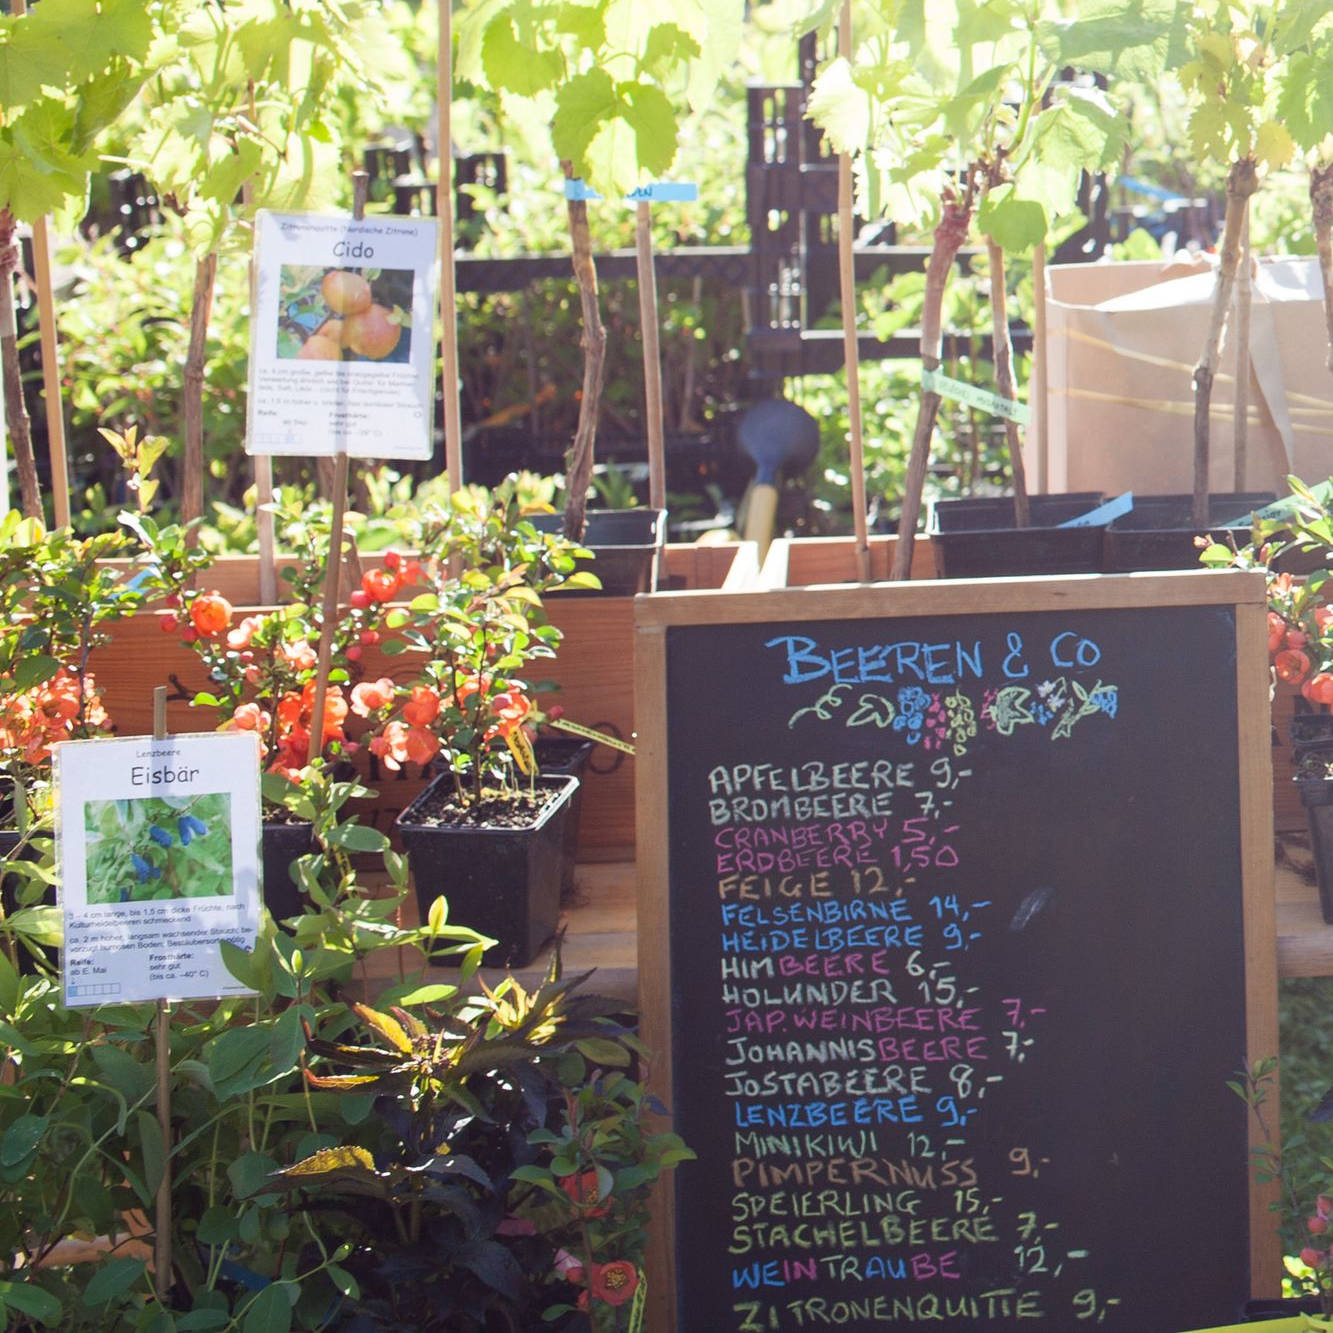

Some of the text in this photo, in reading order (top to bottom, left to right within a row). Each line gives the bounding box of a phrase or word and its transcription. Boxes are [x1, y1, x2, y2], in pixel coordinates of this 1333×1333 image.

[332, 241, 374, 259] Cido
[765, 635, 984, 684] BEEREN
[1002, 632, 1029, 677] &
[130, 766, 200, 786] Eisbär
[708, 762, 915, 794] APFELBEERE
[708, 792, 893, 825] BROMBEERE
[714, 821, 887, 849] CRANBERRY
[717, 847, 878, 874] ERDBEERE
[718, 870, 833, 899] FEIGE
[721, 898, 909, 926] FELSENBIRNE
[721, 950, 891, 980] HIMBEERE
[722, 978, 897, 1006] HOLUNDER
[725, 1035, 989, 1066] JOHANNISBEERE
[725, 1066, 932, 1098] JOSTABEERE
[735, 1095, 923, 1128] LENZBEERE
[735, 1131, 879, 1157] MINIKIWI
[732, 1157, 979, 1187] PIMPERNUSS
[731, 1191, 921, 1222] SPEIERLING
[728, 1214, 1000, 1254] STACHELBEERE
[732, 1252, 961, 1288] WEINTRAUBE
